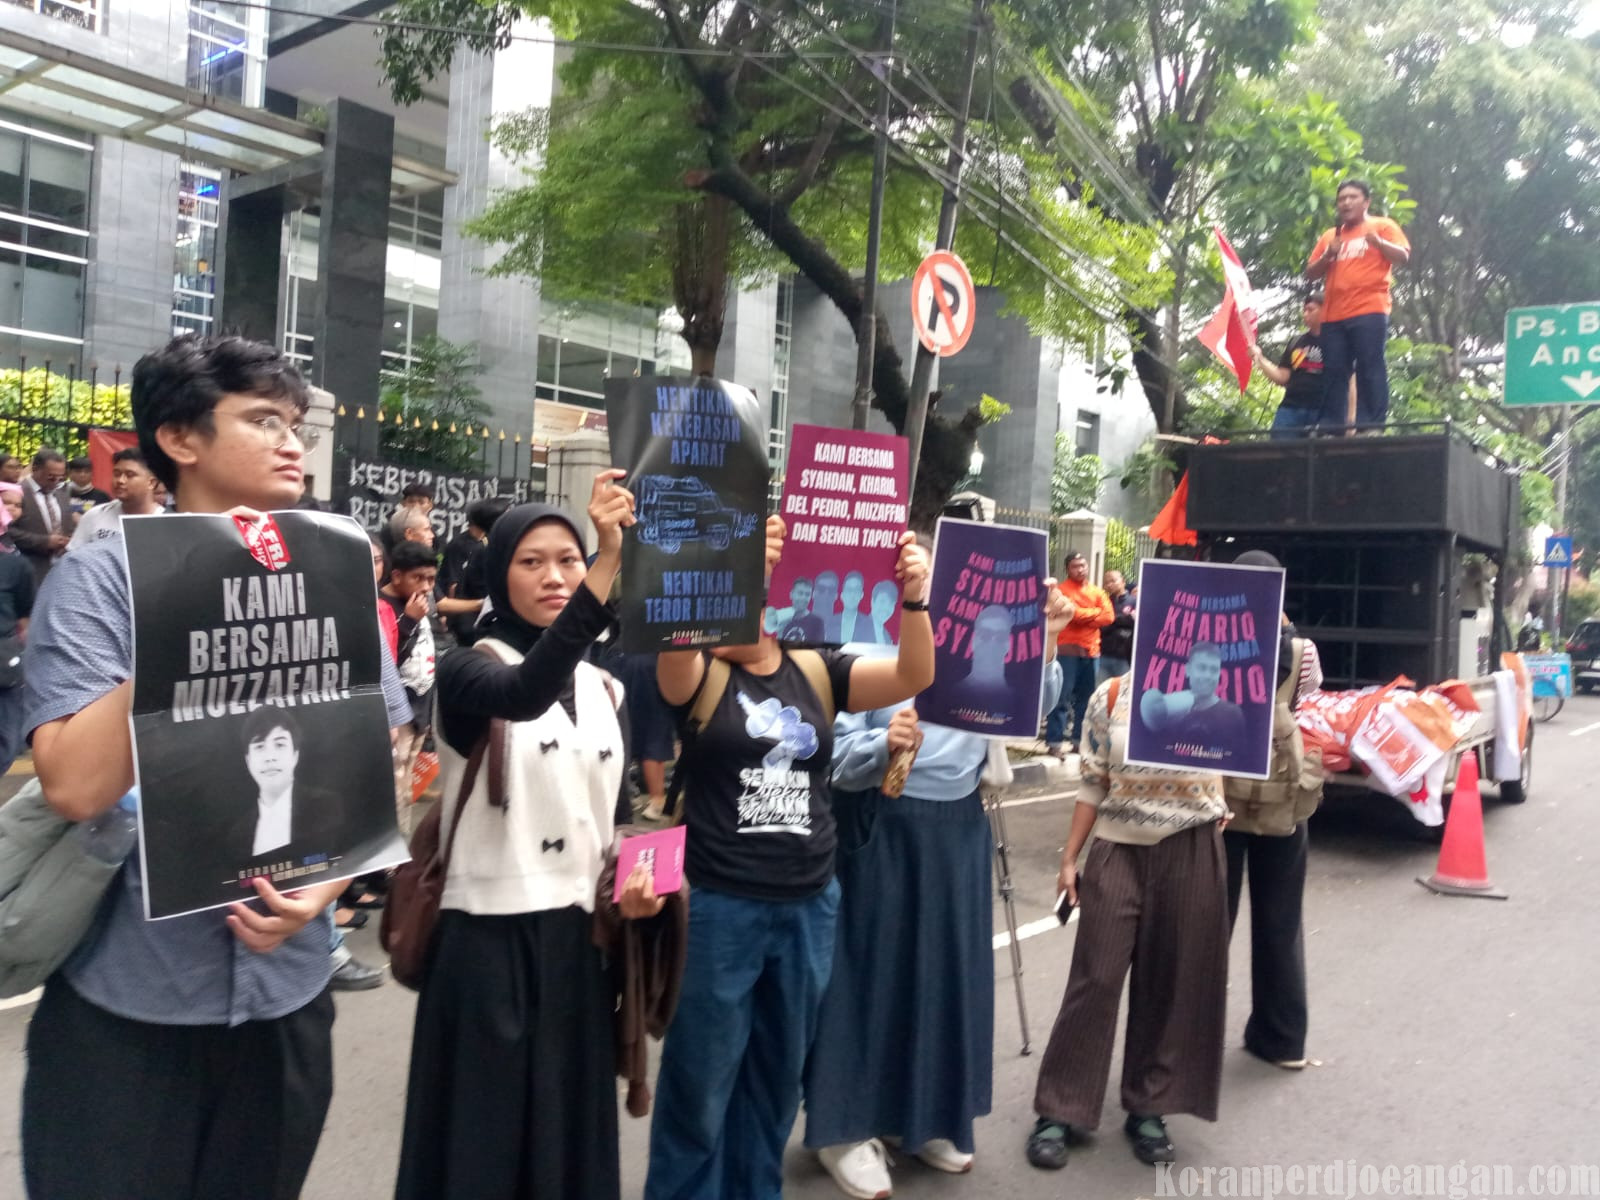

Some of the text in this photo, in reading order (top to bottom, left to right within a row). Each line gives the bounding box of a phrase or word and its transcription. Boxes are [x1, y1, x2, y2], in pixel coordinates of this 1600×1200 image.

[670, 440, 727, 466] APARAT
[814, 442, 894, 469] KAMI BERSAMA
[800, 468, 857, 495] SYAHDAN,
[786, 494, 808, 515] DEL
[811, 497, 851, 521] PEDRO,
[792, 522, 899, 549] DAN SEMUA TAPOL!
[967, 552, 995, 572] KAMI
[222, 572, 307, 622] KAMI
[663, 571, 734, 596] HENTIKAN
[955, 568, 1037, 604] SYAHDAN
[645, 595, 747, 623] TEROR NEGARA
[1173, 590, 1199, 609] KAMI
[1164, 605, 1256, 643] KHARIQ
[189, 617, 339, 674] BERSAMA
[172, 661, 351, 722] MUZZAFAR!
[1142, 654, 1266, 704] KHRIQ
